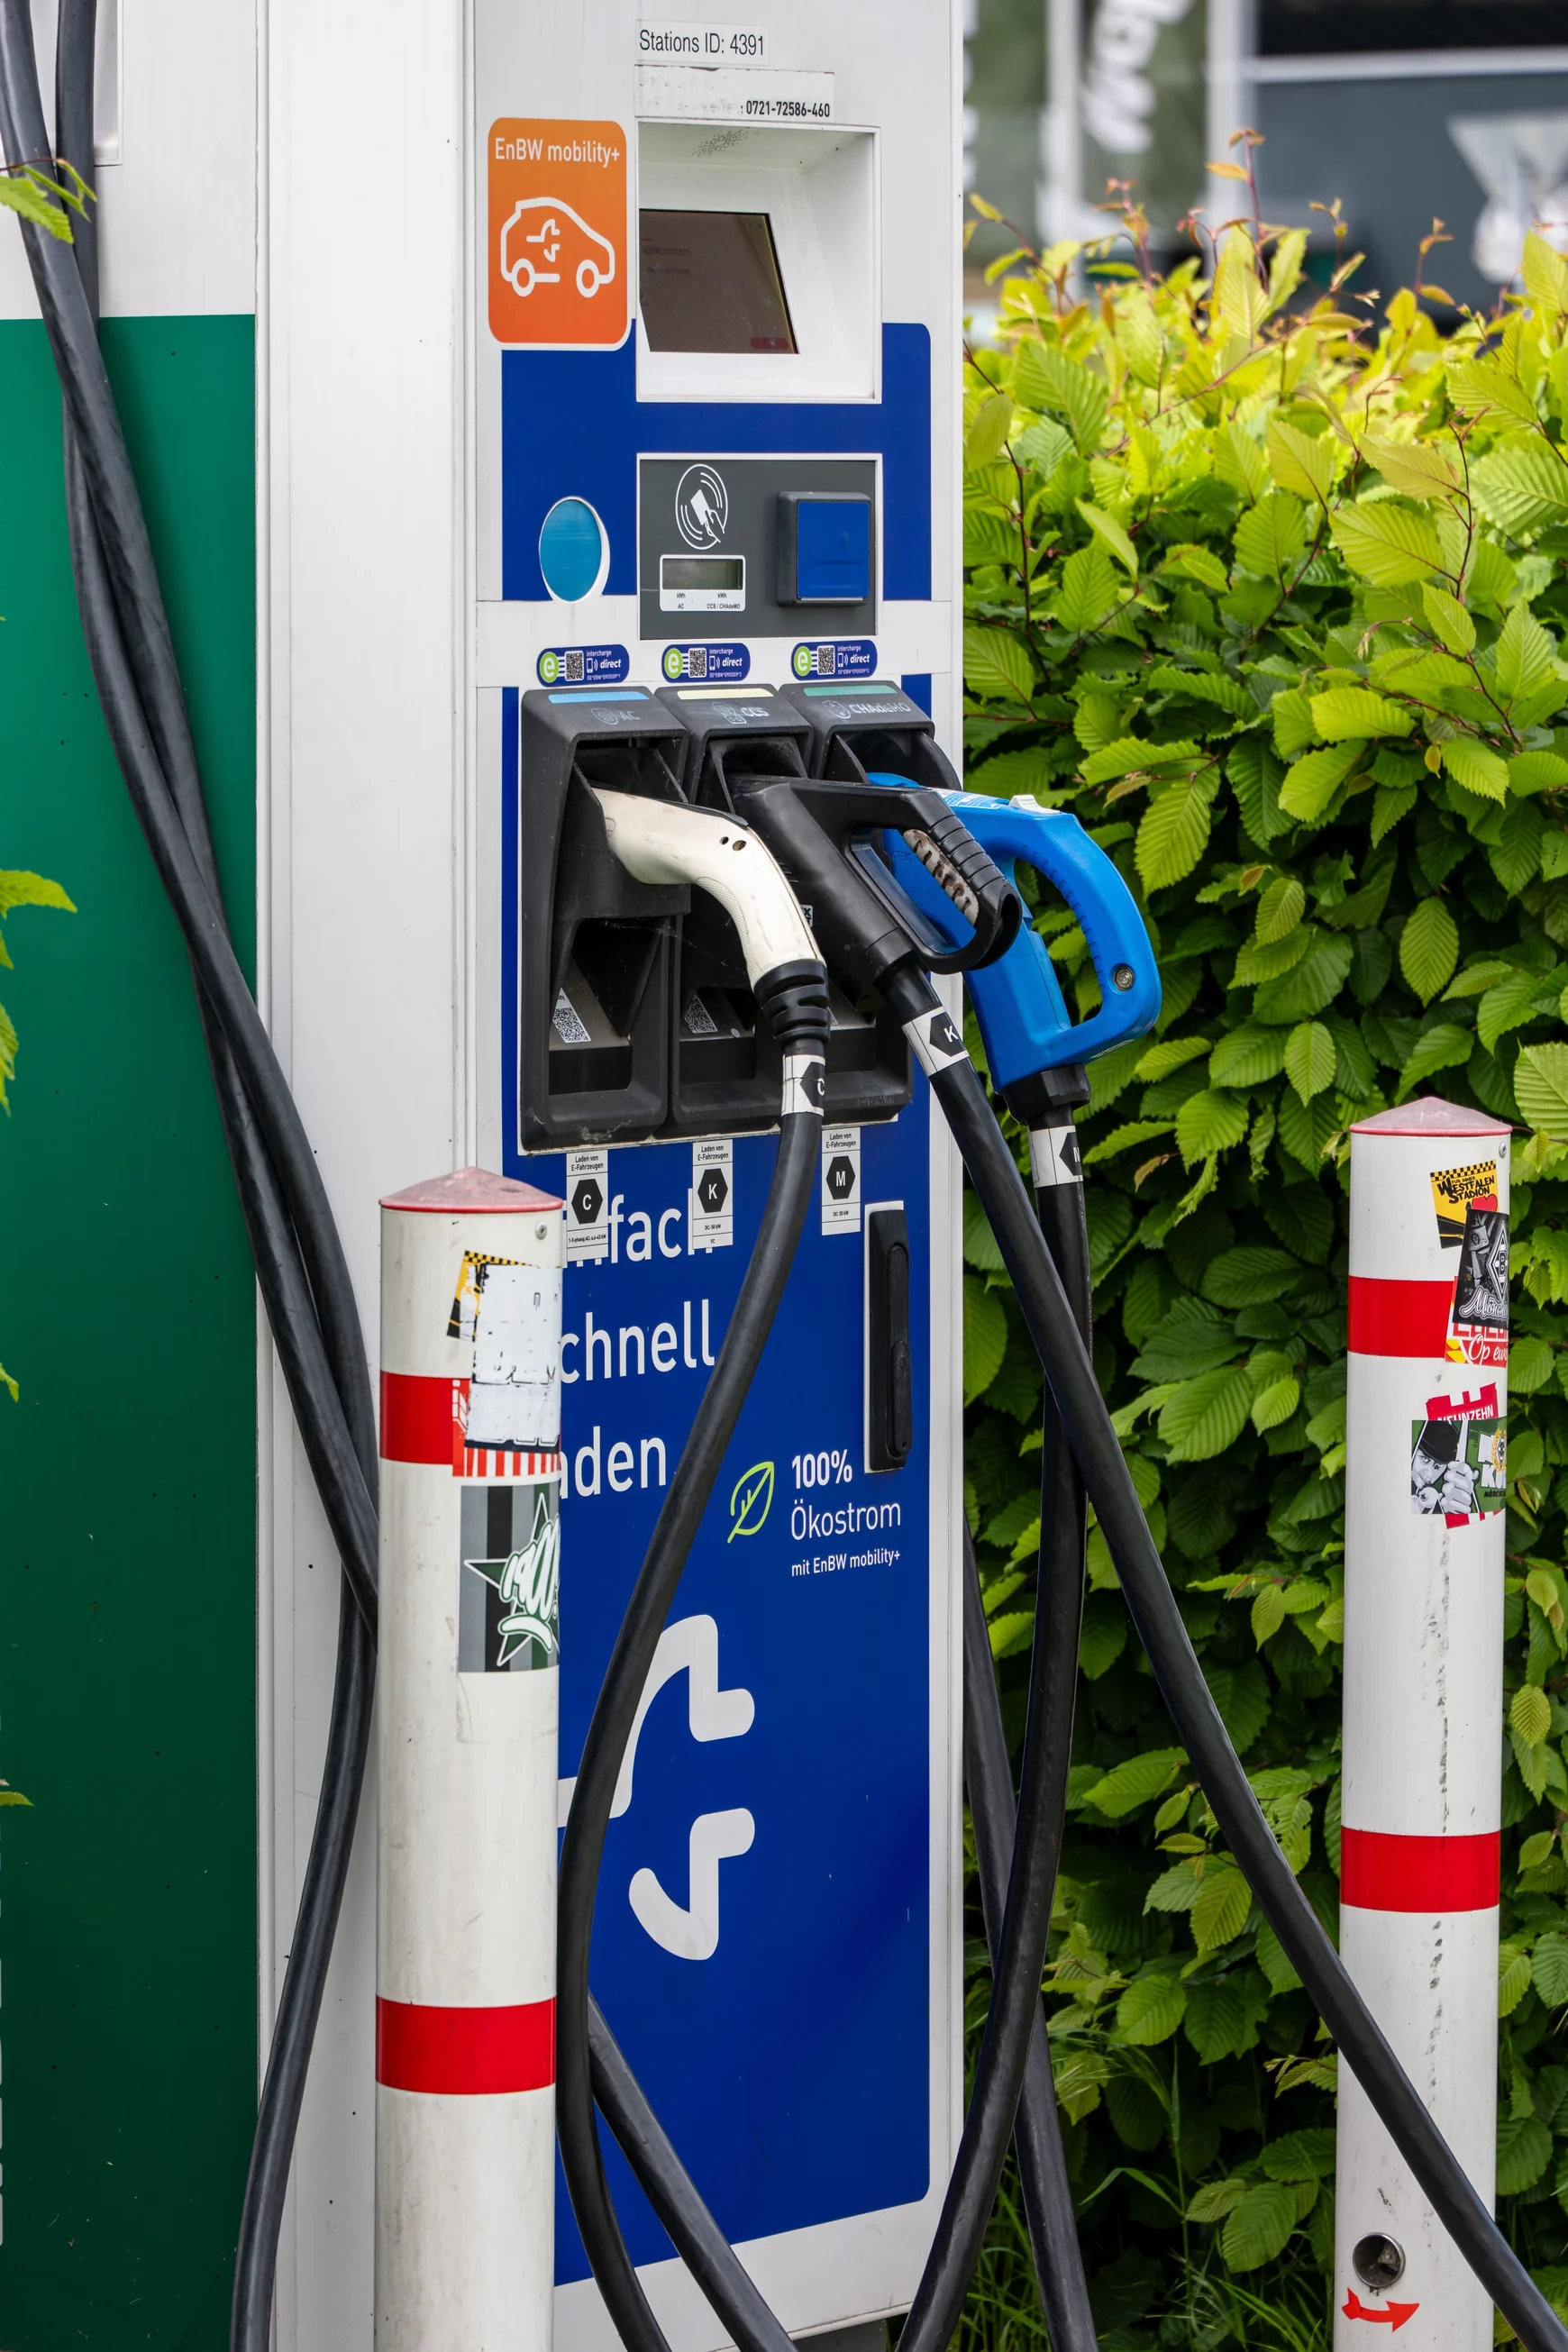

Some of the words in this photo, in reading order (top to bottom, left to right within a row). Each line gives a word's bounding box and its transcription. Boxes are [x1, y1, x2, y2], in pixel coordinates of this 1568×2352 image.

[639, 30, 700, 55] Stations
[704, 32, 726, 54] ID:
[729, 32, 765, 57] 4391
[746, 99, 831, 118] 0721-72586-460
[495, 138, 542, 161] EnBW
[547, 141, 620, 168] mobility+
[586, 650, 612, 658] intercharge
[708, 647, 734, 655] intercharge
[837, 645, 861, 654] intercharge
[599, 659, 622, 670] direct
[722, 657, 743, 667] direct
[850, 653, 871, 665] direct
[621, 710, 641, 722] AC
[743, 707, 770, 717] CCS
[850, 702, 912, 716] CHAdeMO
[944, 1026, 960, 1044] K
[700, 1145, 716, 1153] Laden
[825, 1141, 857, 1149] E-Fahrzeugen
[575, 1155, 589, 1163] Laden
[697, 1153, 729, 1162] E-Fahrzeugen
[570, 1162, 604, 1171] E-Fahrzeugen
[835, 1171, 846, 1187] M
[1436, 1175, 1495, 1197] WESTFALEN
[708, 1183, 718, 1200] K
[1448, 1185, 1491, 1204] STADION
[582, 1194, 592, 1211] C
[561, 1299, 716, 1384] chnell
[561, 1426, 667, 1500] den
[791, 1449, 852, 1490] 100%
[790, 1499, 901, 1541] Ökostrom
[791, 1560, 810, 1578] mit
[813, 1553, 847, 1574] EnBW
[849, 1548, 901, 1571] mobility+
